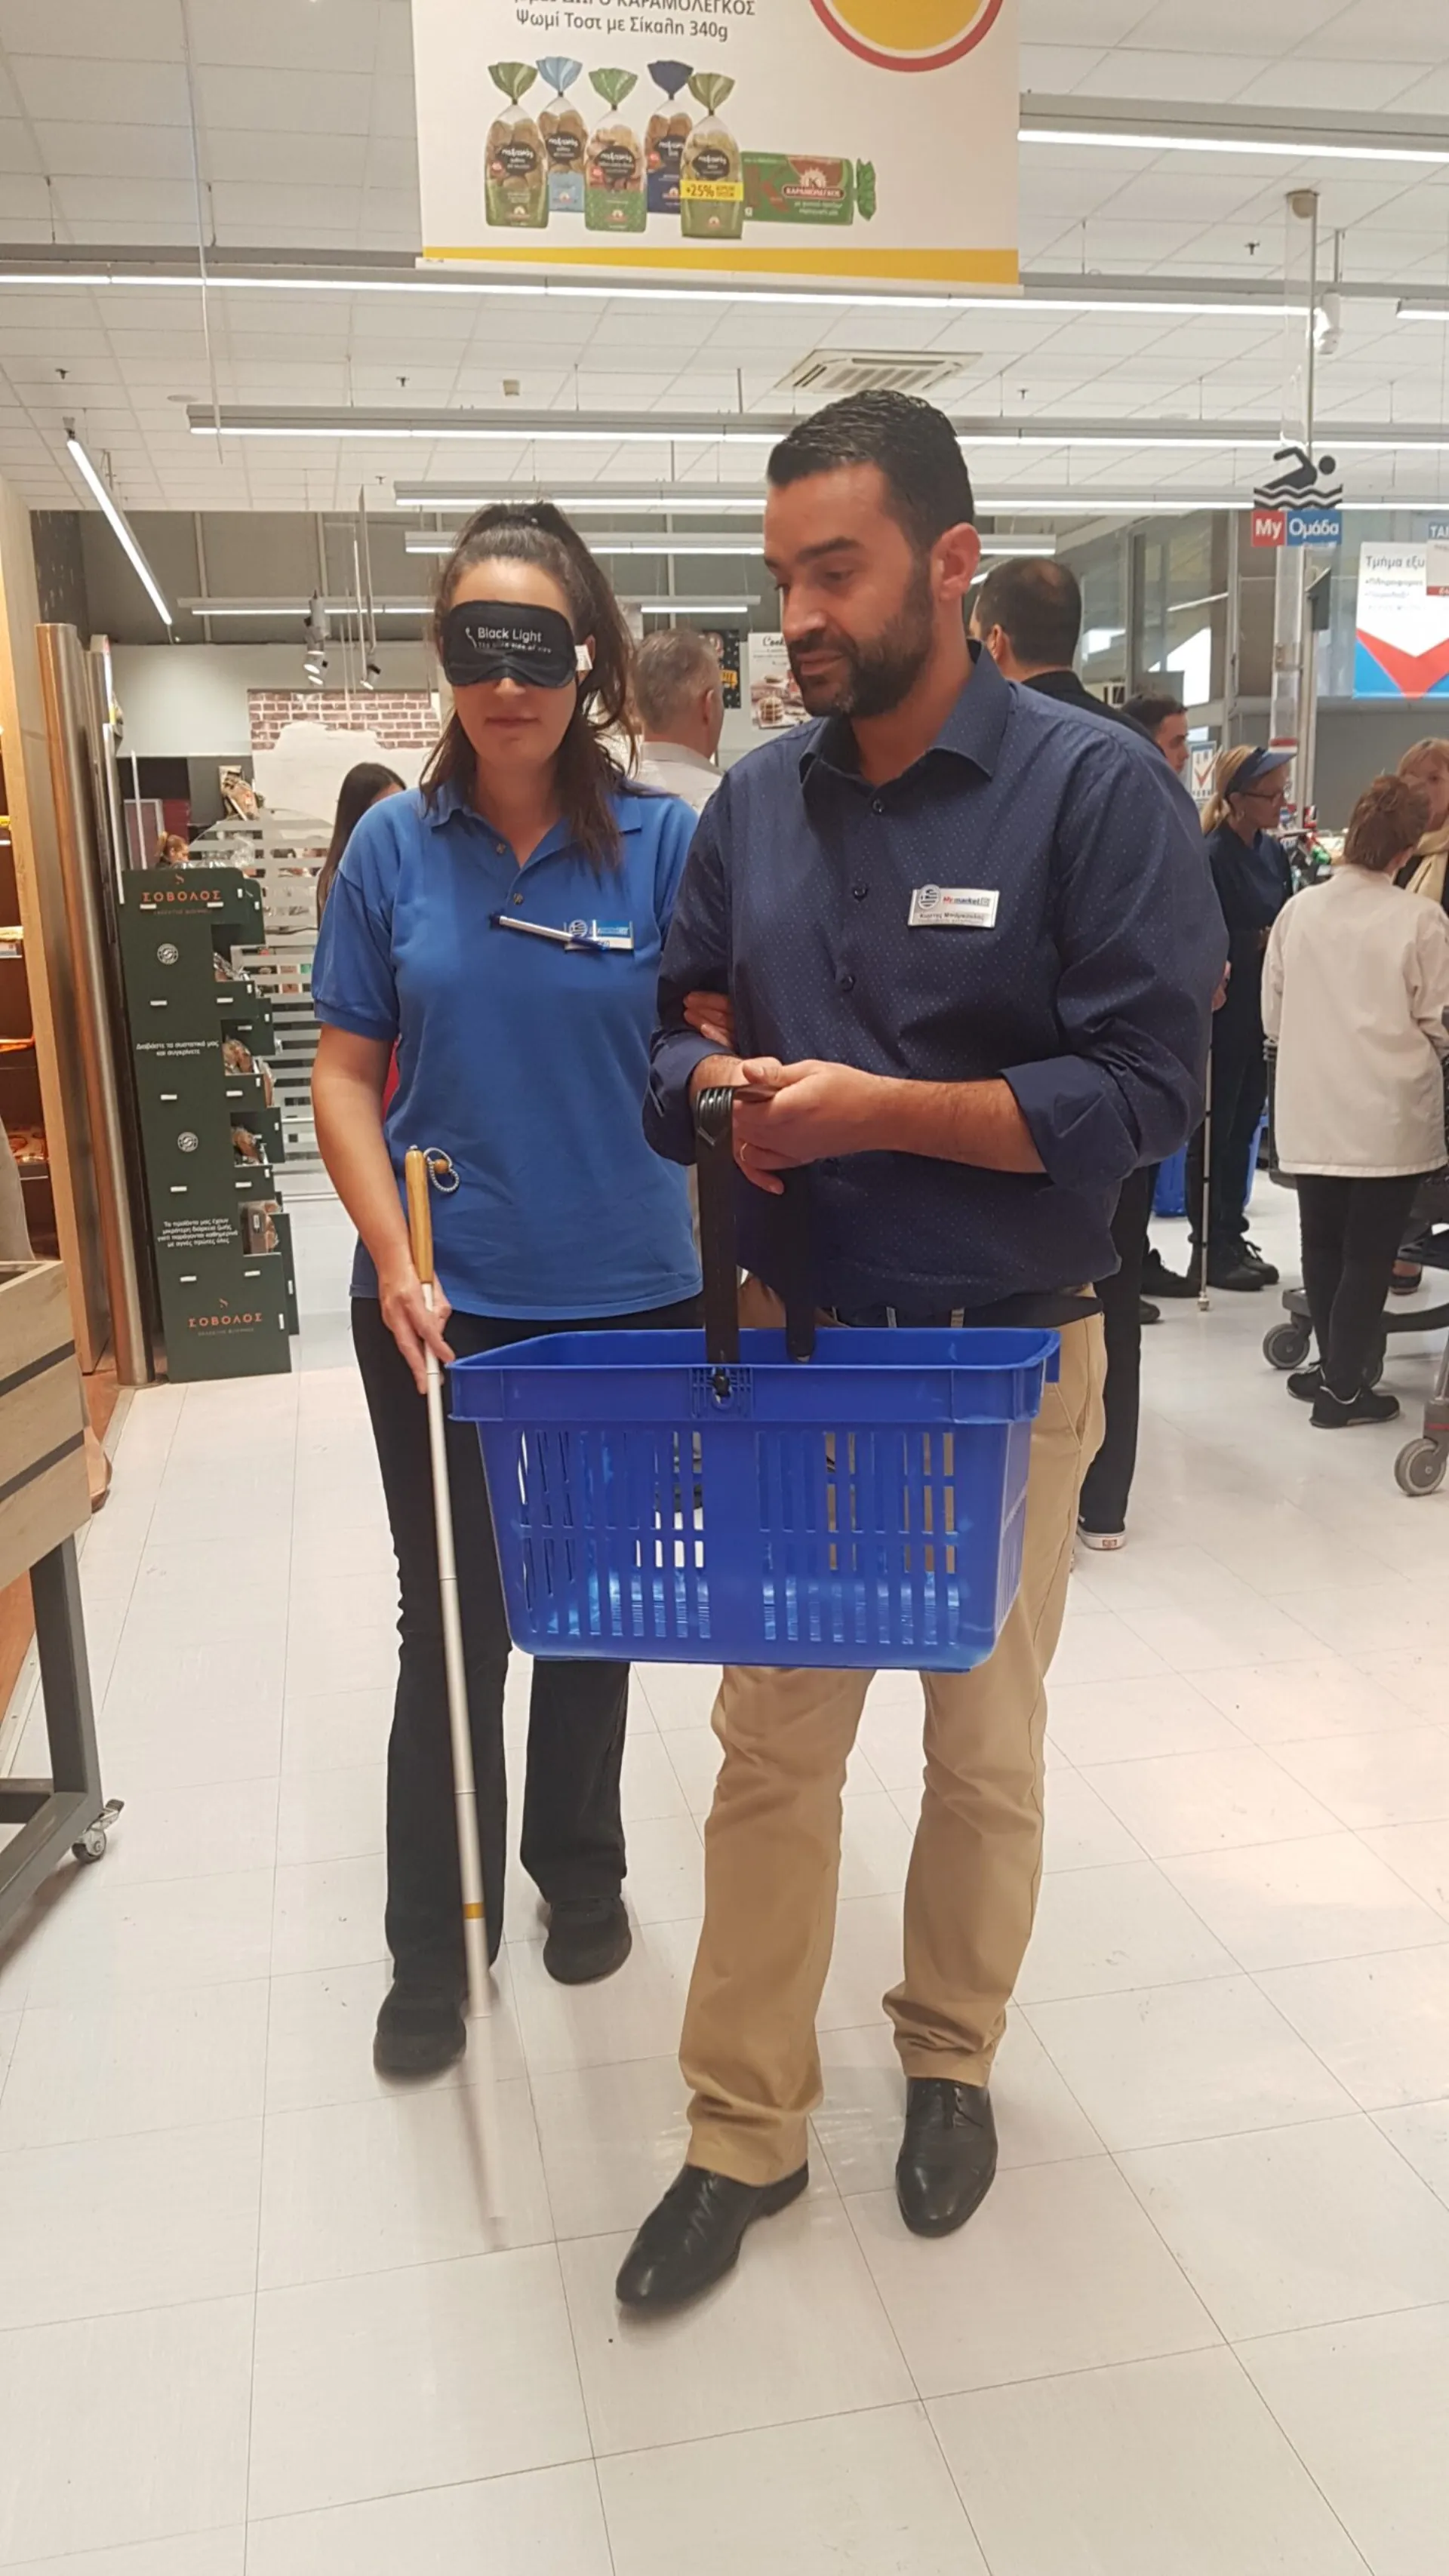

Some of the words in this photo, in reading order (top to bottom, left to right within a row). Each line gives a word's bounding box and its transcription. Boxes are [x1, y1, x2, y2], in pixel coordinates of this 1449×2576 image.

[517, 8, 559, 30] Ψωμί
[565, 12, 601, 29] Τοστ
[607, 18, 626, 34] με
[630, 16, 685, 35] Σίκαλη
[690, 20, 728, 42] 340g
[1255, 518, 1282, 540] My
[1288, 518, 1340, 539] Ομάδα
[1365, 555, 1402, 570] Τμήμα
[478, 627, 509, 639] Black
[512, 628, 542, 643] Light
[142, 890, 221, 902] ΣΟΒΟΛΟΣ
[188, 1312, 263, 1327] ΣΟΒΟΛΟΣ
